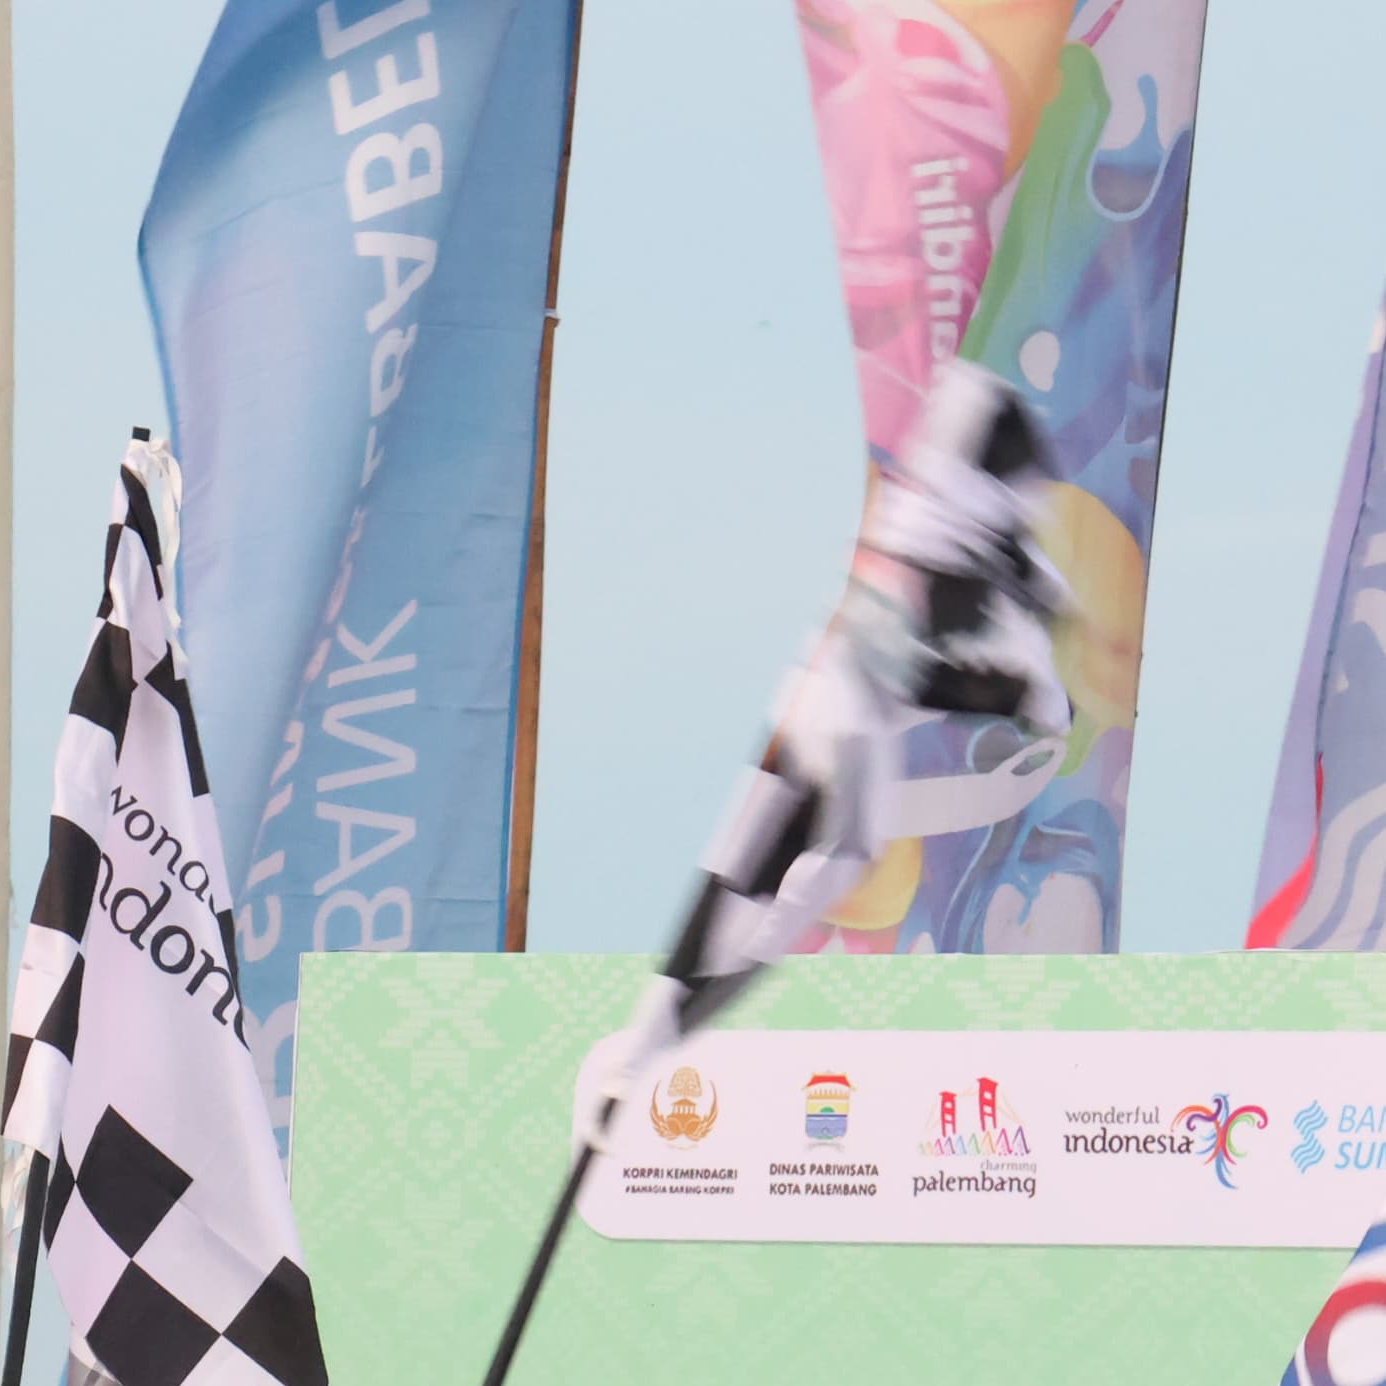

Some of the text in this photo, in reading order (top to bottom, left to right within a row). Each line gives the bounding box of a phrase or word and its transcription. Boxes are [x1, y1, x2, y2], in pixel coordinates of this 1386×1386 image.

[1065, 1105, 1159, 1125] wonderful
[1064, 1125, 1196, 1155] indonesia
[623, 1167, 738, 1181] KORPRI KEMENDAGRI
[769, 1163, 879, 1177] DINAS PARIWISATA
[769, 1183, 878, 1197] KOTA PALEMBANG
[913, 1170, 1037, 1199] palembang
